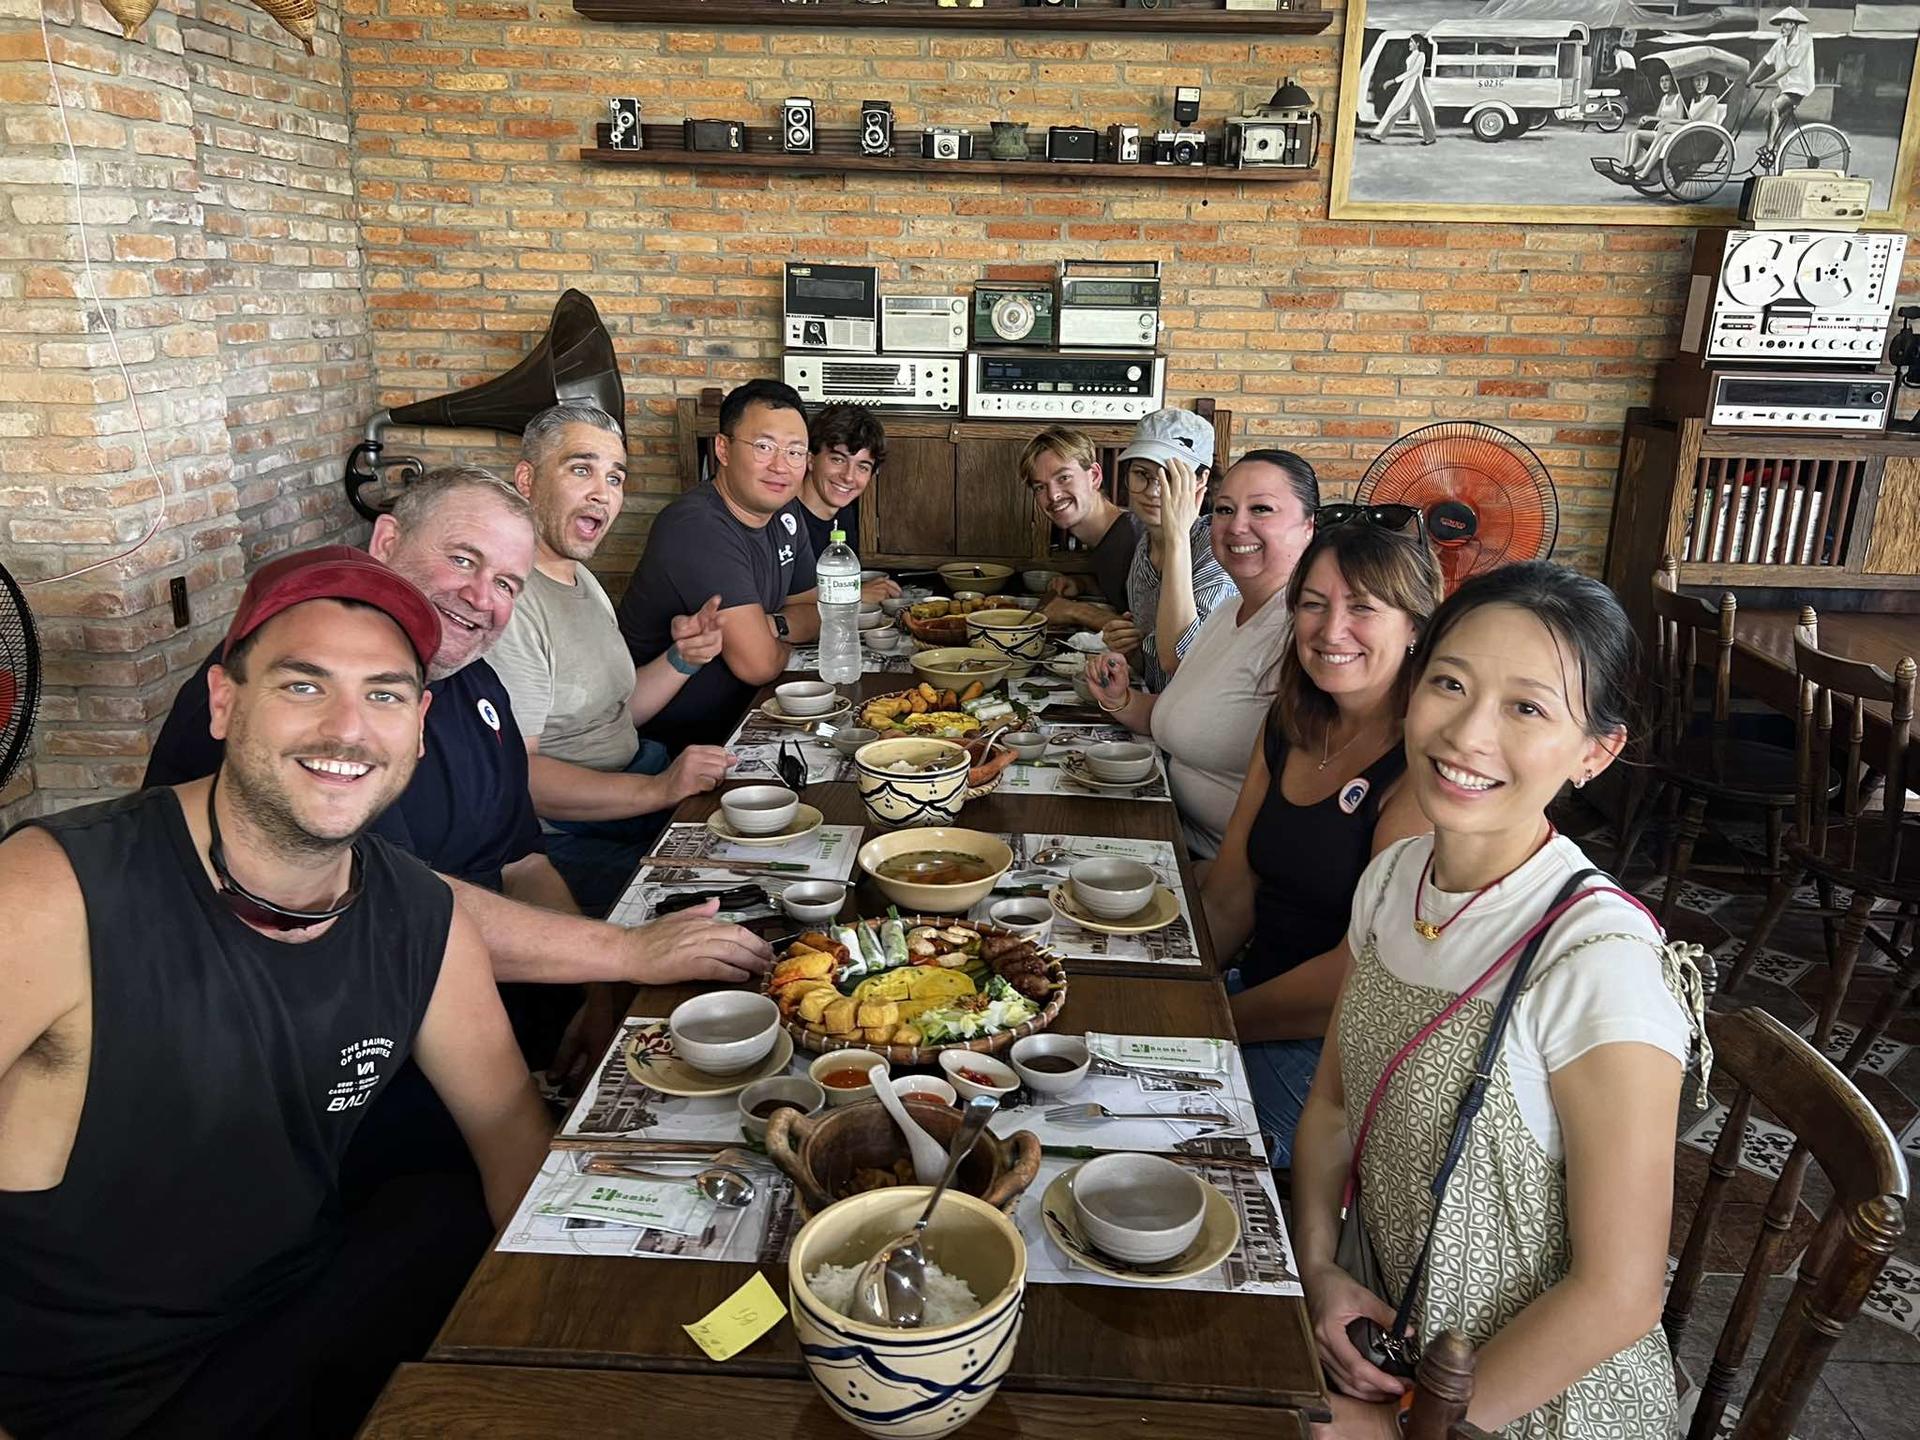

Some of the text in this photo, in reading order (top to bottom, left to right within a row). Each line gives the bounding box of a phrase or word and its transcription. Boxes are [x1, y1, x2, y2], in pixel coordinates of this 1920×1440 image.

[341, 1038, 395, 1056] THE BALANCE
[340, 1048, 391, 1067] OF OPPOSITES
